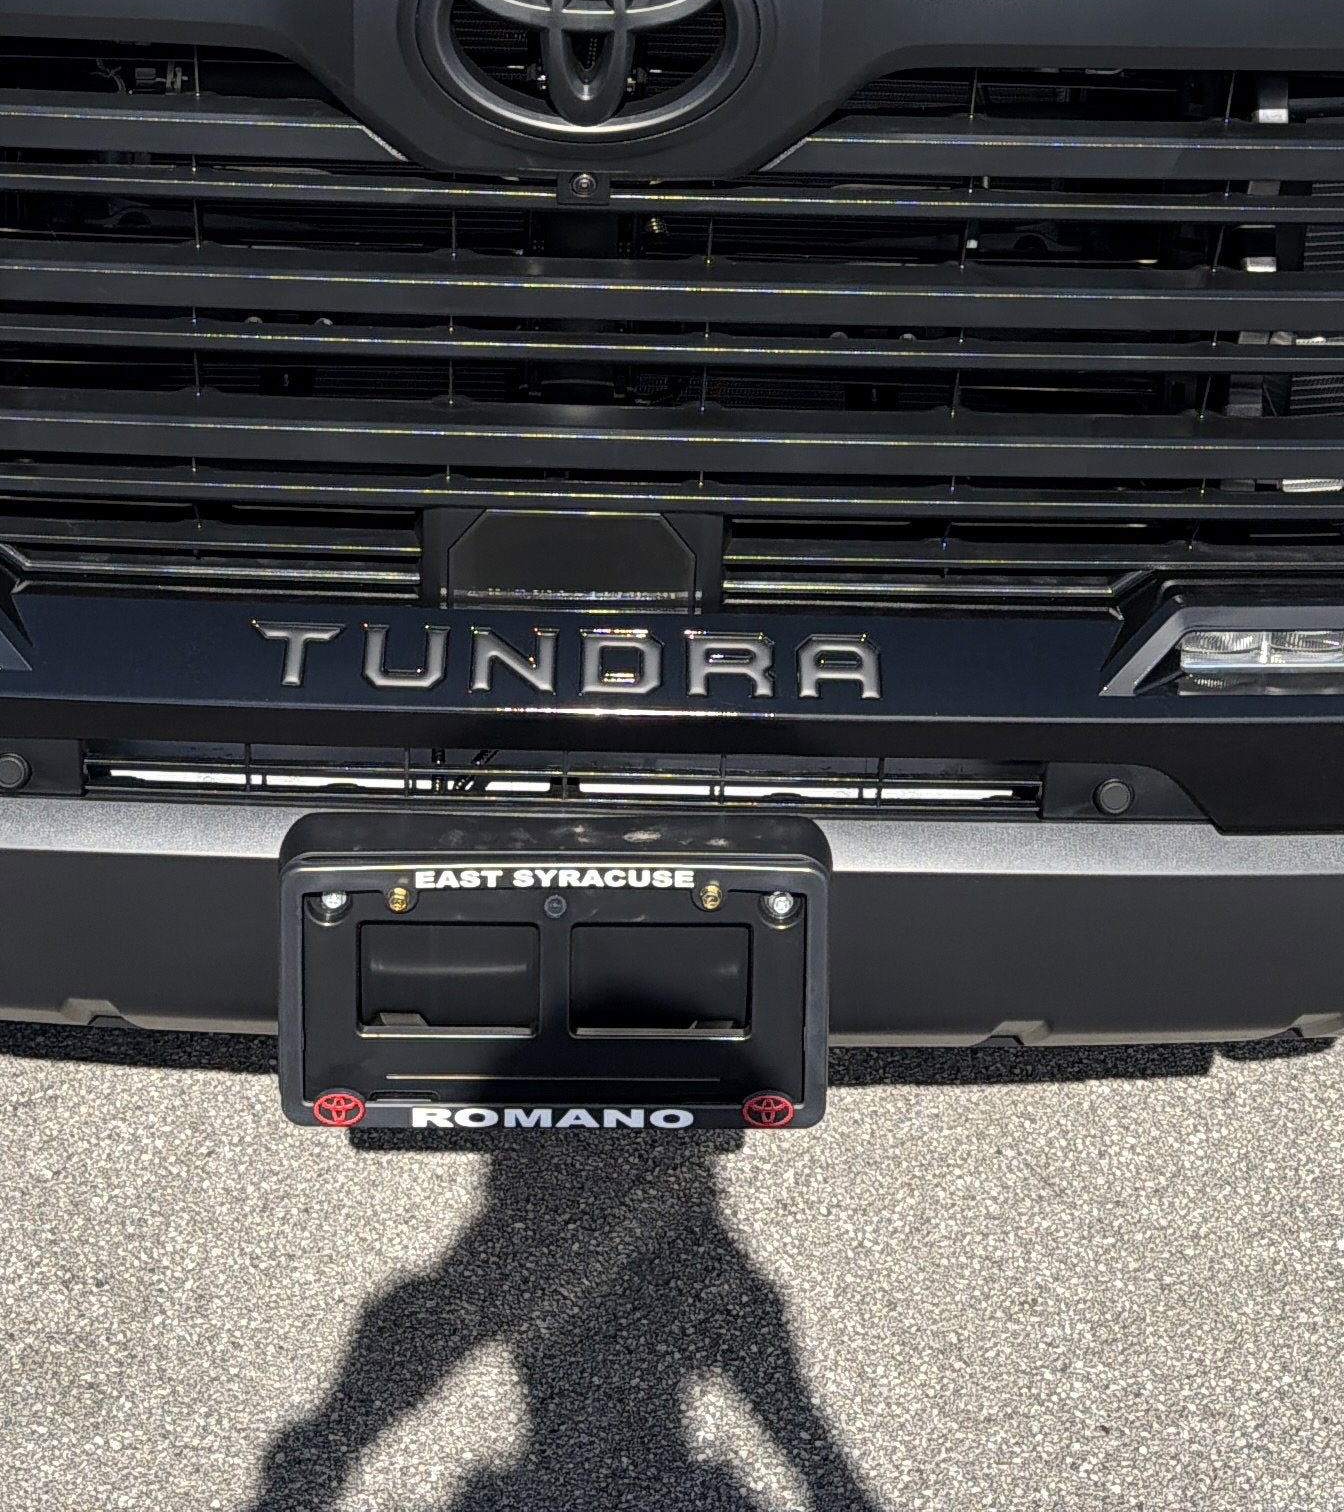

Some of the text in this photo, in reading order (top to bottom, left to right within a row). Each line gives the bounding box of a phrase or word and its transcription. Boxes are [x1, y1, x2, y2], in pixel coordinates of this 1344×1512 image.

[252, 621, 883, 700] TUNDRA
[415, 869, 695, 888] EAST SYRACUSE
[411, 1107, 694, 1129] ROMANO
